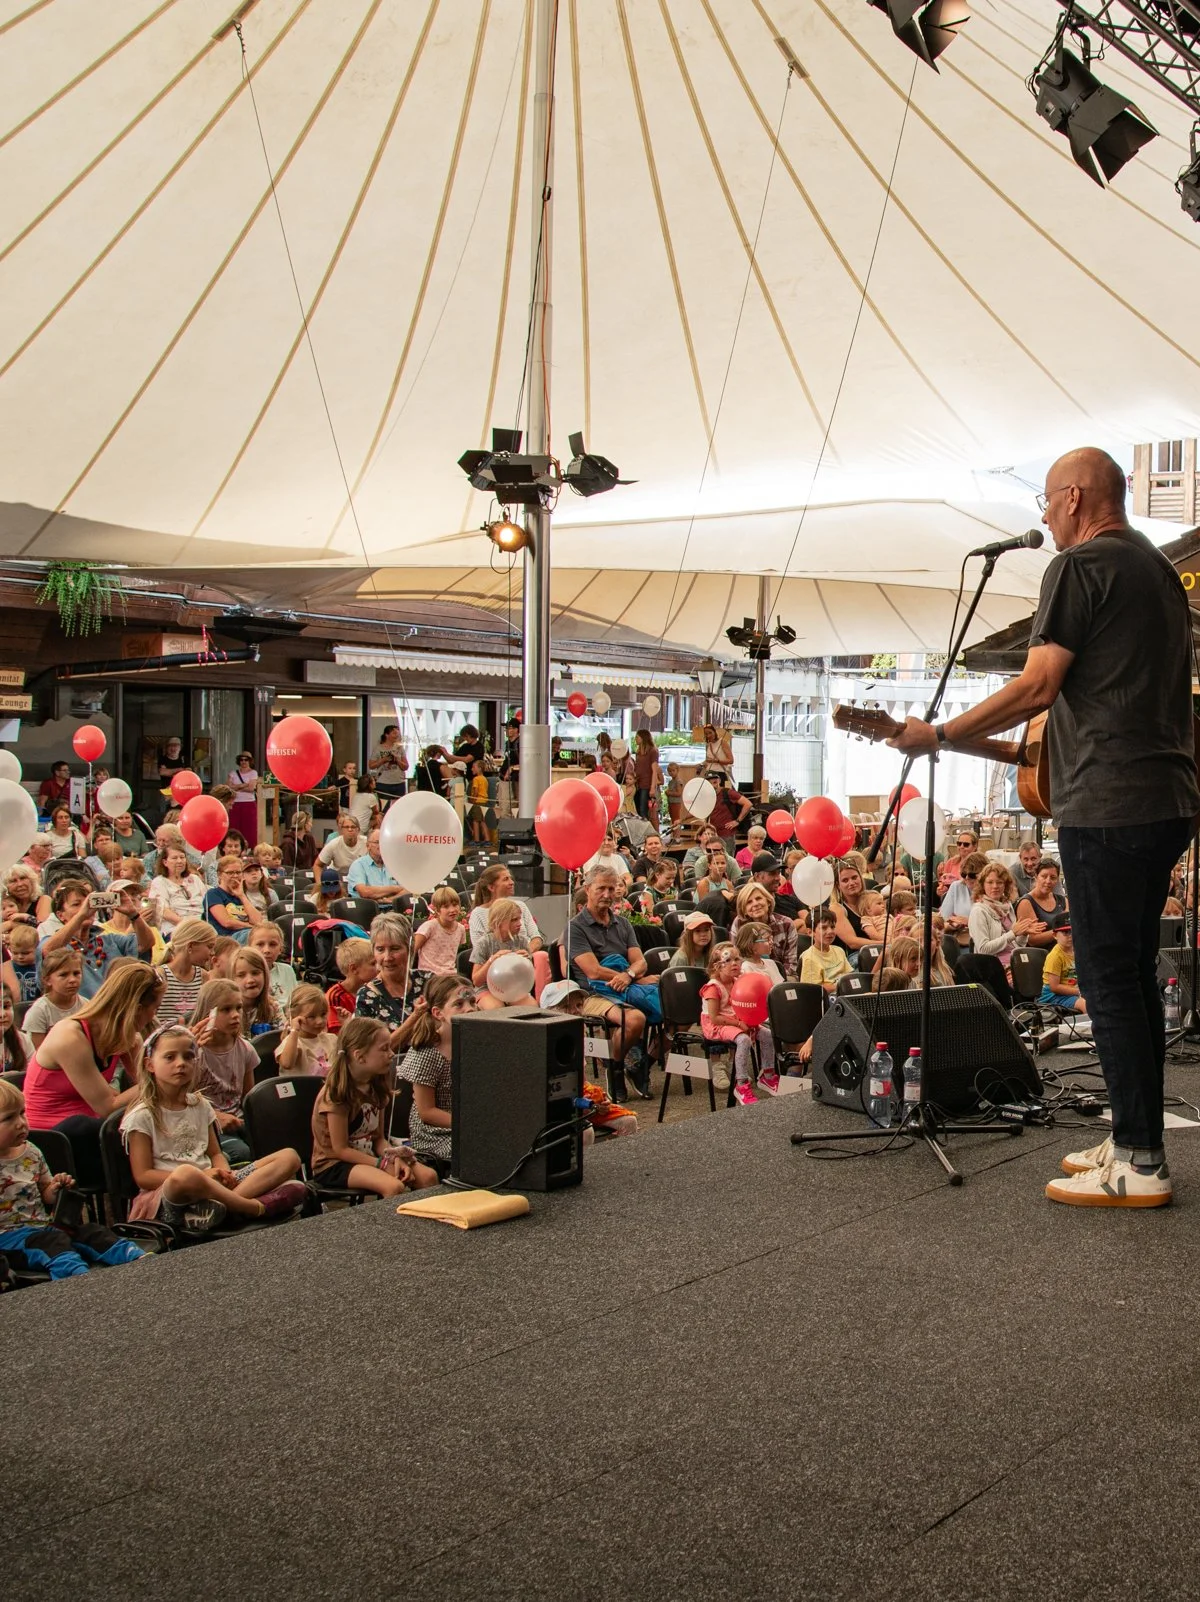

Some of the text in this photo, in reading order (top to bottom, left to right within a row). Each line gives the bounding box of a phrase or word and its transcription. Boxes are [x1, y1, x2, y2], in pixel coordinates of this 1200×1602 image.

[74, 793, 81, 806] A
[406, 834, 456, 845] RAIFFEISEN
[588, 1042, 594, 1052] 3
[684, 1060, 691, 1072] 2
[282, 1085, 289, 1094] 3
